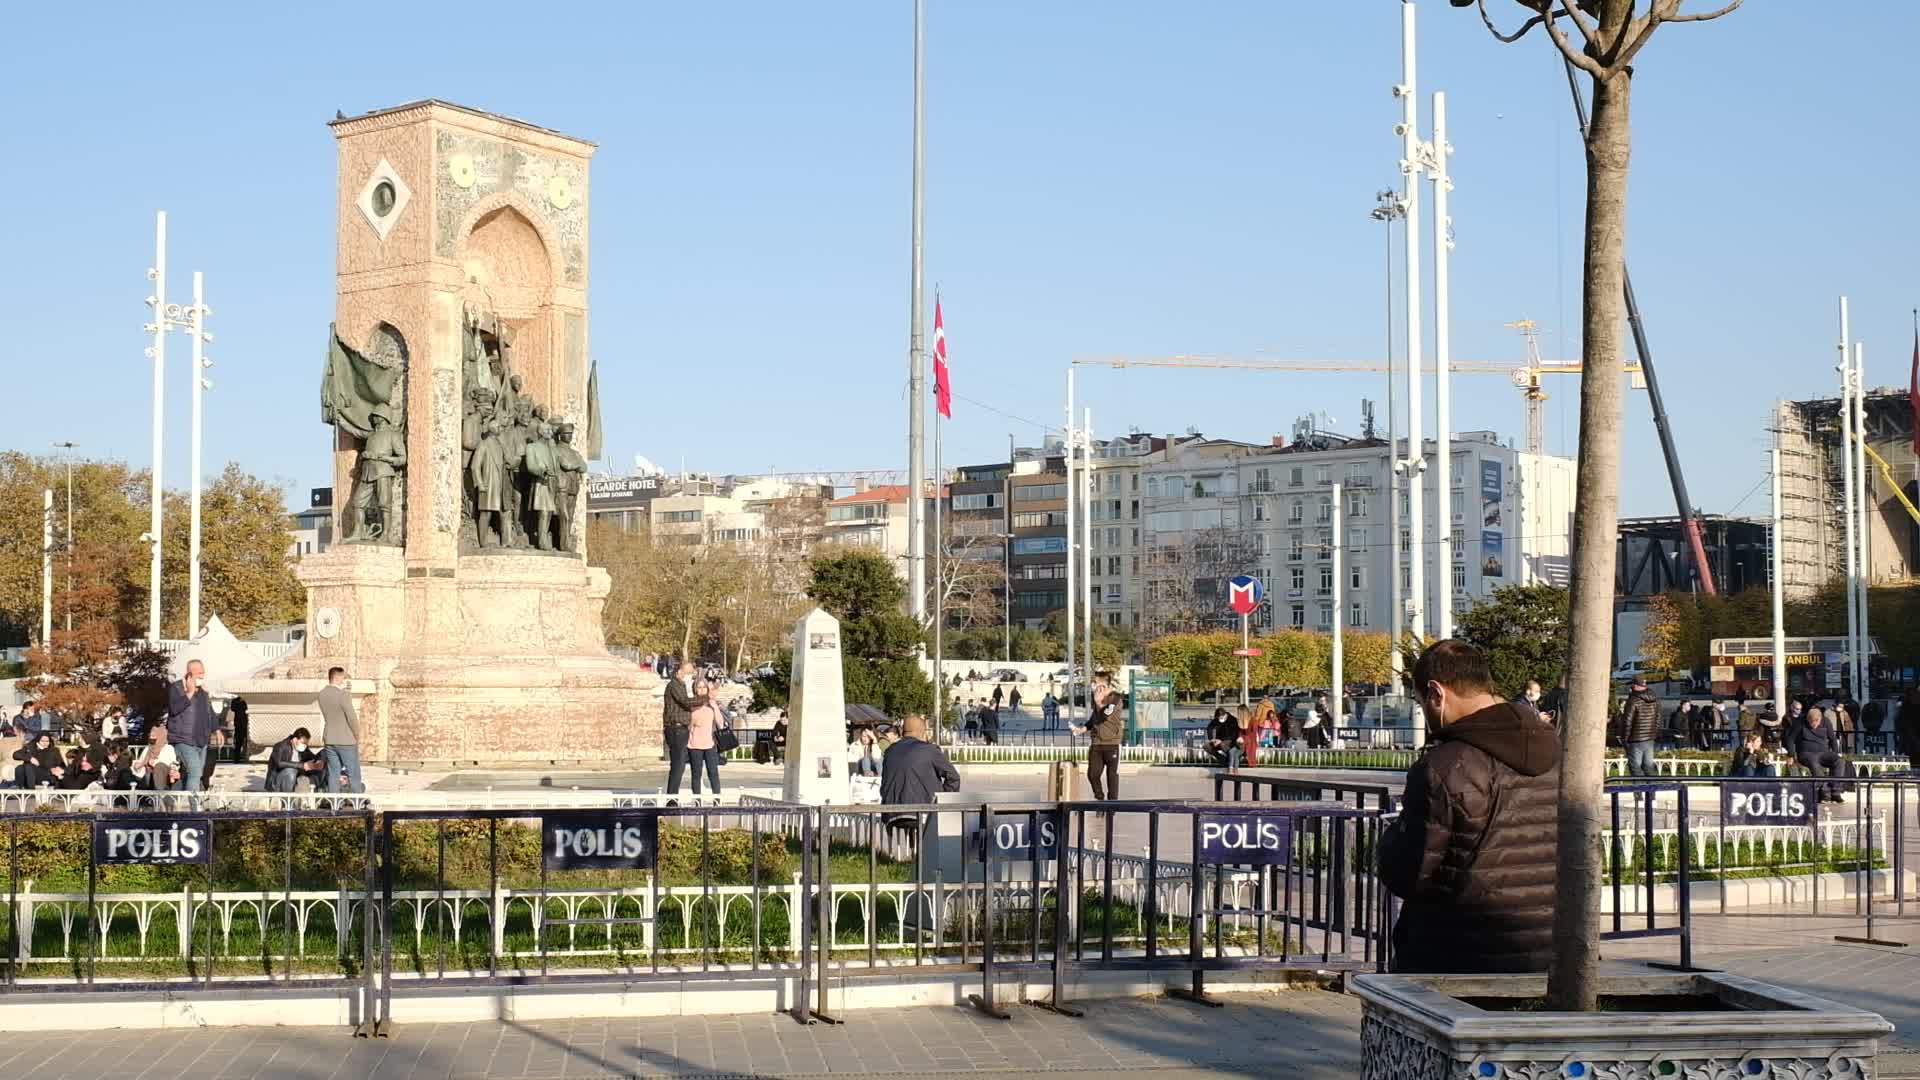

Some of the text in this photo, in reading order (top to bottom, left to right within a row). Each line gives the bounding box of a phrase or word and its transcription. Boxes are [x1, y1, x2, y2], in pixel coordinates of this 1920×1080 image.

[628, 479, 657, 490] HOTEL
[1229, 580, 1254, 604] M
[1730, 788, 1805, 817] POLİS
[107, 822, 201, 858] POLİS
[554, 822, 643, 858] POLİS
[993, 821, 1056, 850] OLS
[1203, 818, 1280, 849] POLİS
